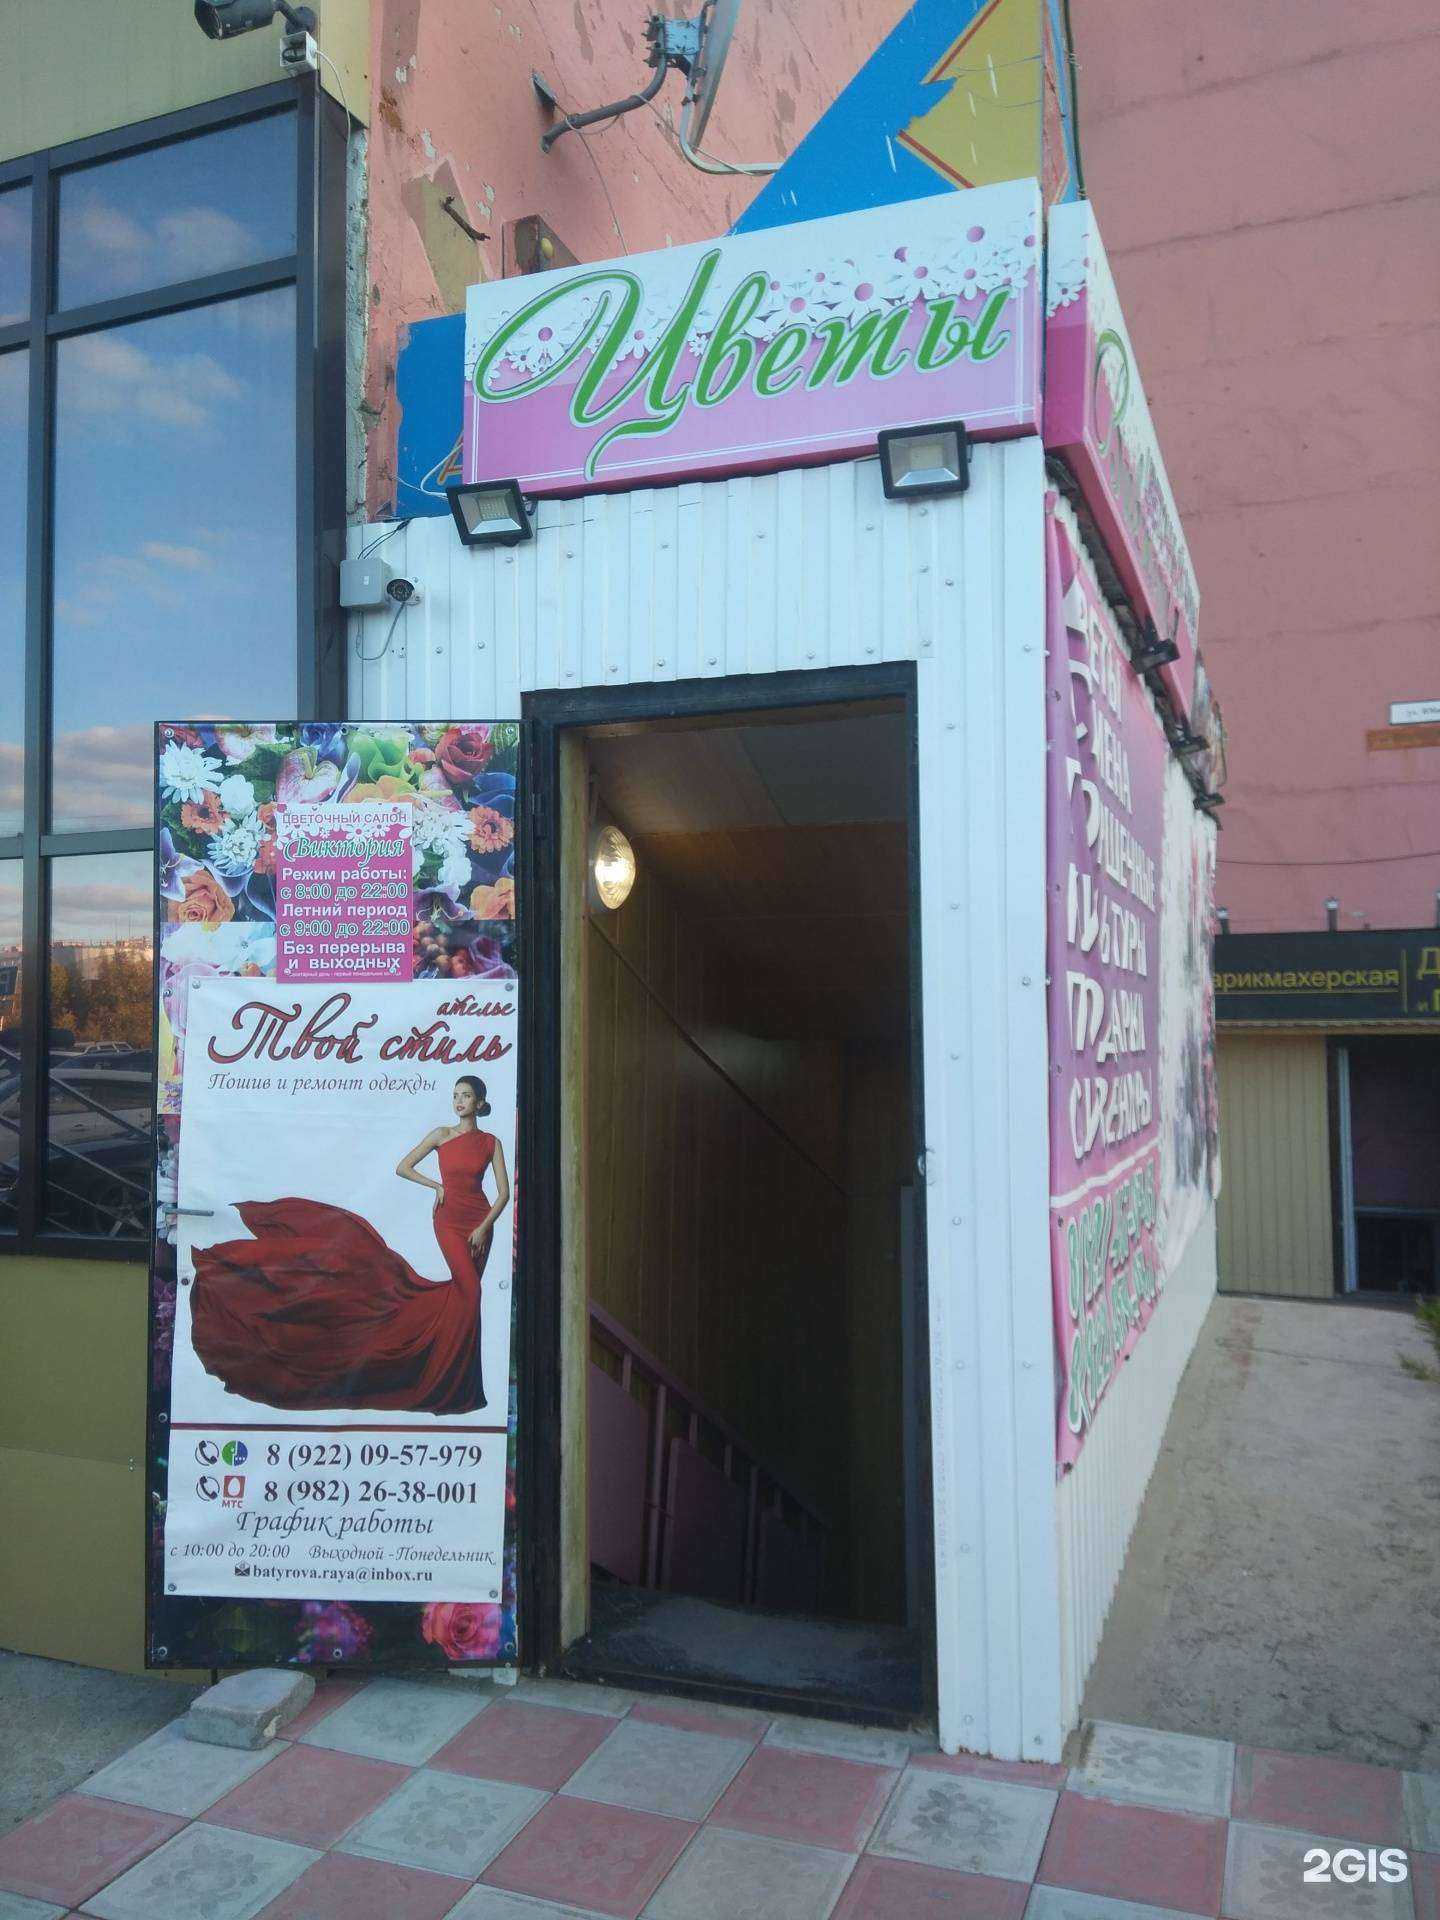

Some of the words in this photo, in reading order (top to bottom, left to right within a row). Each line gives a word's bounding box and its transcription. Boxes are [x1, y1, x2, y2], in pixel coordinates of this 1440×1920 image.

[471, 248, 1013, 482] Цветы
[282, 812, 361, 825] ЦВЕТОЧНЫЙ
[364, 813, 407, 824] САЛОН
[283, 837, 405, 867] Виктория
[282, 868, 336, 881] Режим
[341, 867, 407, 883] работы:
[280, 886, 292, 899] с
[294, 883, 332, 900] 8:00
[335, 886, 358, 901] до
[361, 883, 408, 899] 22:00
[282, 903, 342, 917] Летний
[347, 905, 408, 919] период
[280, 924, 291, 937] с
[294, 920, 332, 937] 9:00
[335, 923, 358, 939] до
[362, 919, 410, 936] 22:00
[283, 941, 314, 955] Без
[320, 942, 406, 957] перерыва
[288, 958, 299, 970] и
[309, 957, 401, 971] выходных
[1213, 968, 1400, 992] арикмахерская
[436, 994, 517, 1017] ателье
[207, 992, 379, 1065] Твой
[379, 1021, 513, 1064] стиль
[208, 1073, 272, 1091] Пошив
[277, 1077, 288, 1091] и
[291, 1077, 363, 1096] ремонт
[368, 1073, 437, 1096] одежды
[266, 1444, 280, 1466] 8
[288, 1444, 352, 1471] (922)
[360, 1444, 482, 1467] 09-57-979
[264, 1480, 278, 1502] 8
[287, 1479, 350, 1507] (982)
[359, 1480, 478, 1504] 26-38-001
[222, 1500, 243, 1509] МТС
[236, 1507, 338, 1539] График
[337, 1508, 433, 1540] работы
[170, 1546, 178, 1557] с
[183, 1543, 224, 1558] 10:00
[228, 1542, 245, 1558] до
[249, 1543, 290, 1558] 20:00
[308, 1544, 384, 1563] Выходной
[253, 1564, 433, 1583] batyrova.raya@inbox.ru
